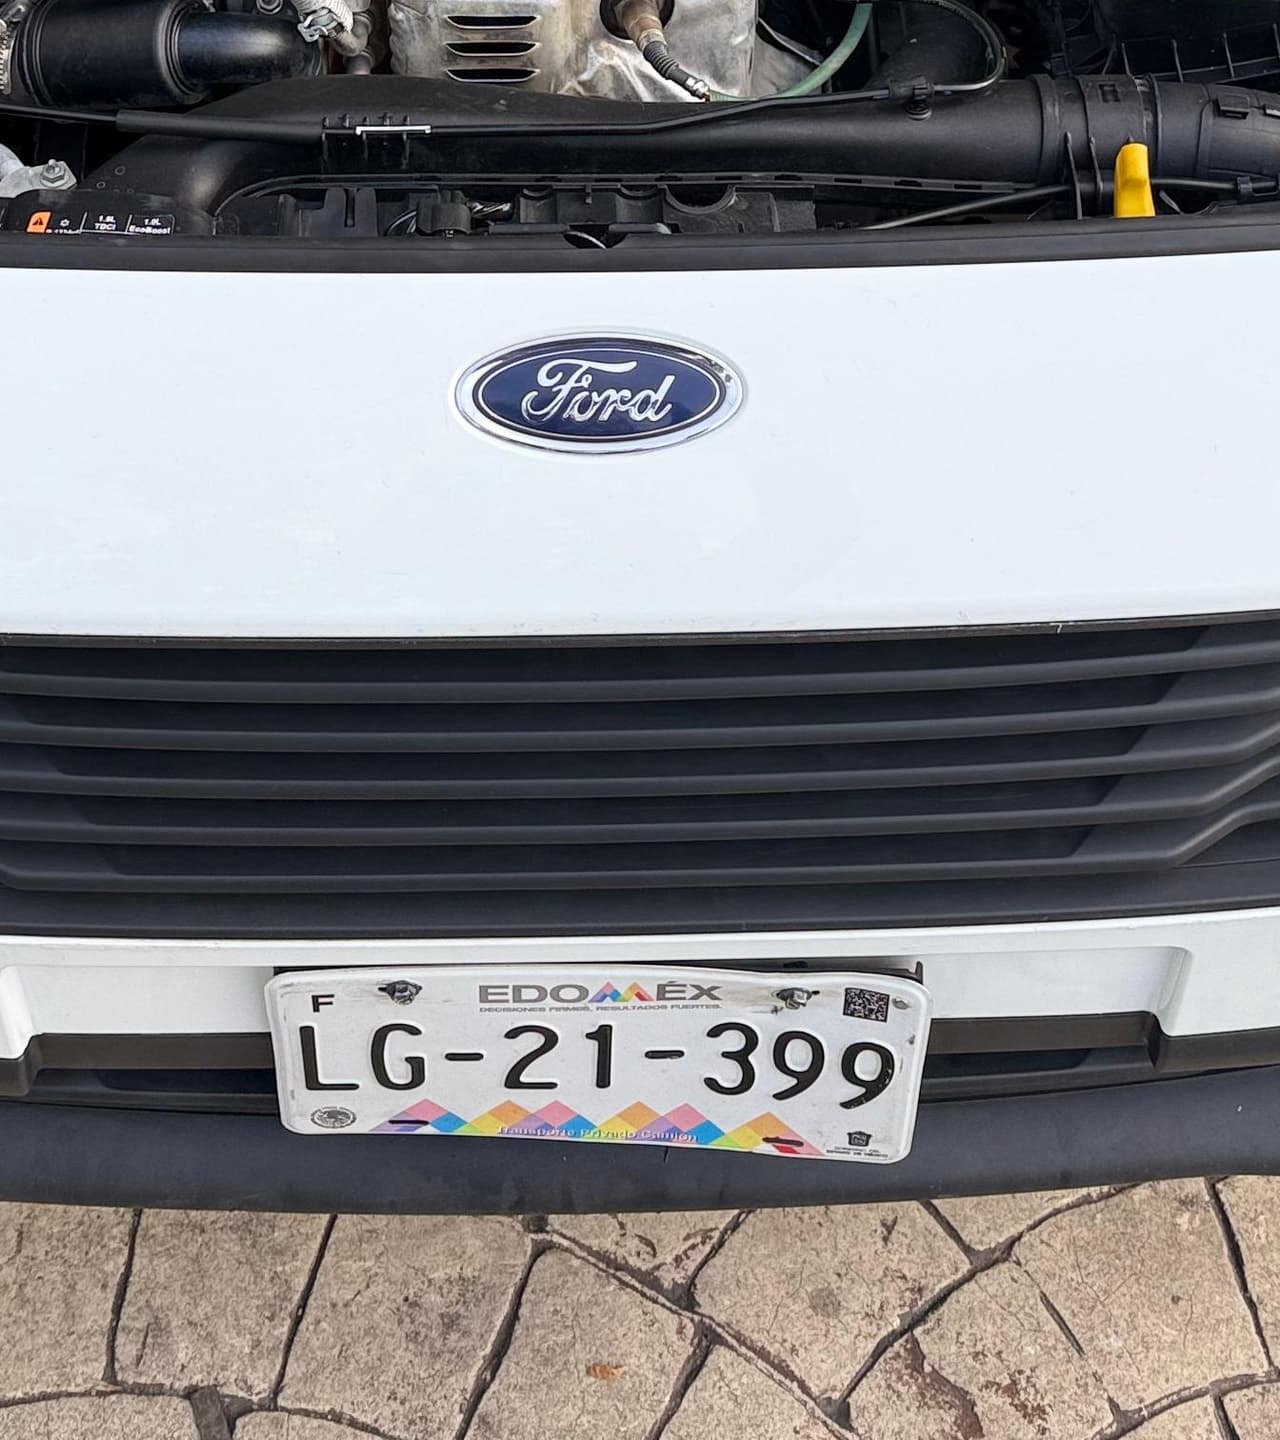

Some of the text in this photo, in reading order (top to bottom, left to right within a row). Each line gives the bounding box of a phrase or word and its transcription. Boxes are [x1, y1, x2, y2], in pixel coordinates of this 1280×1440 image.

[521, 358, 676, 423] Ford
[311, 994, 335, 1013] F
[299, 1022, 895, 1110] LG-21-399
